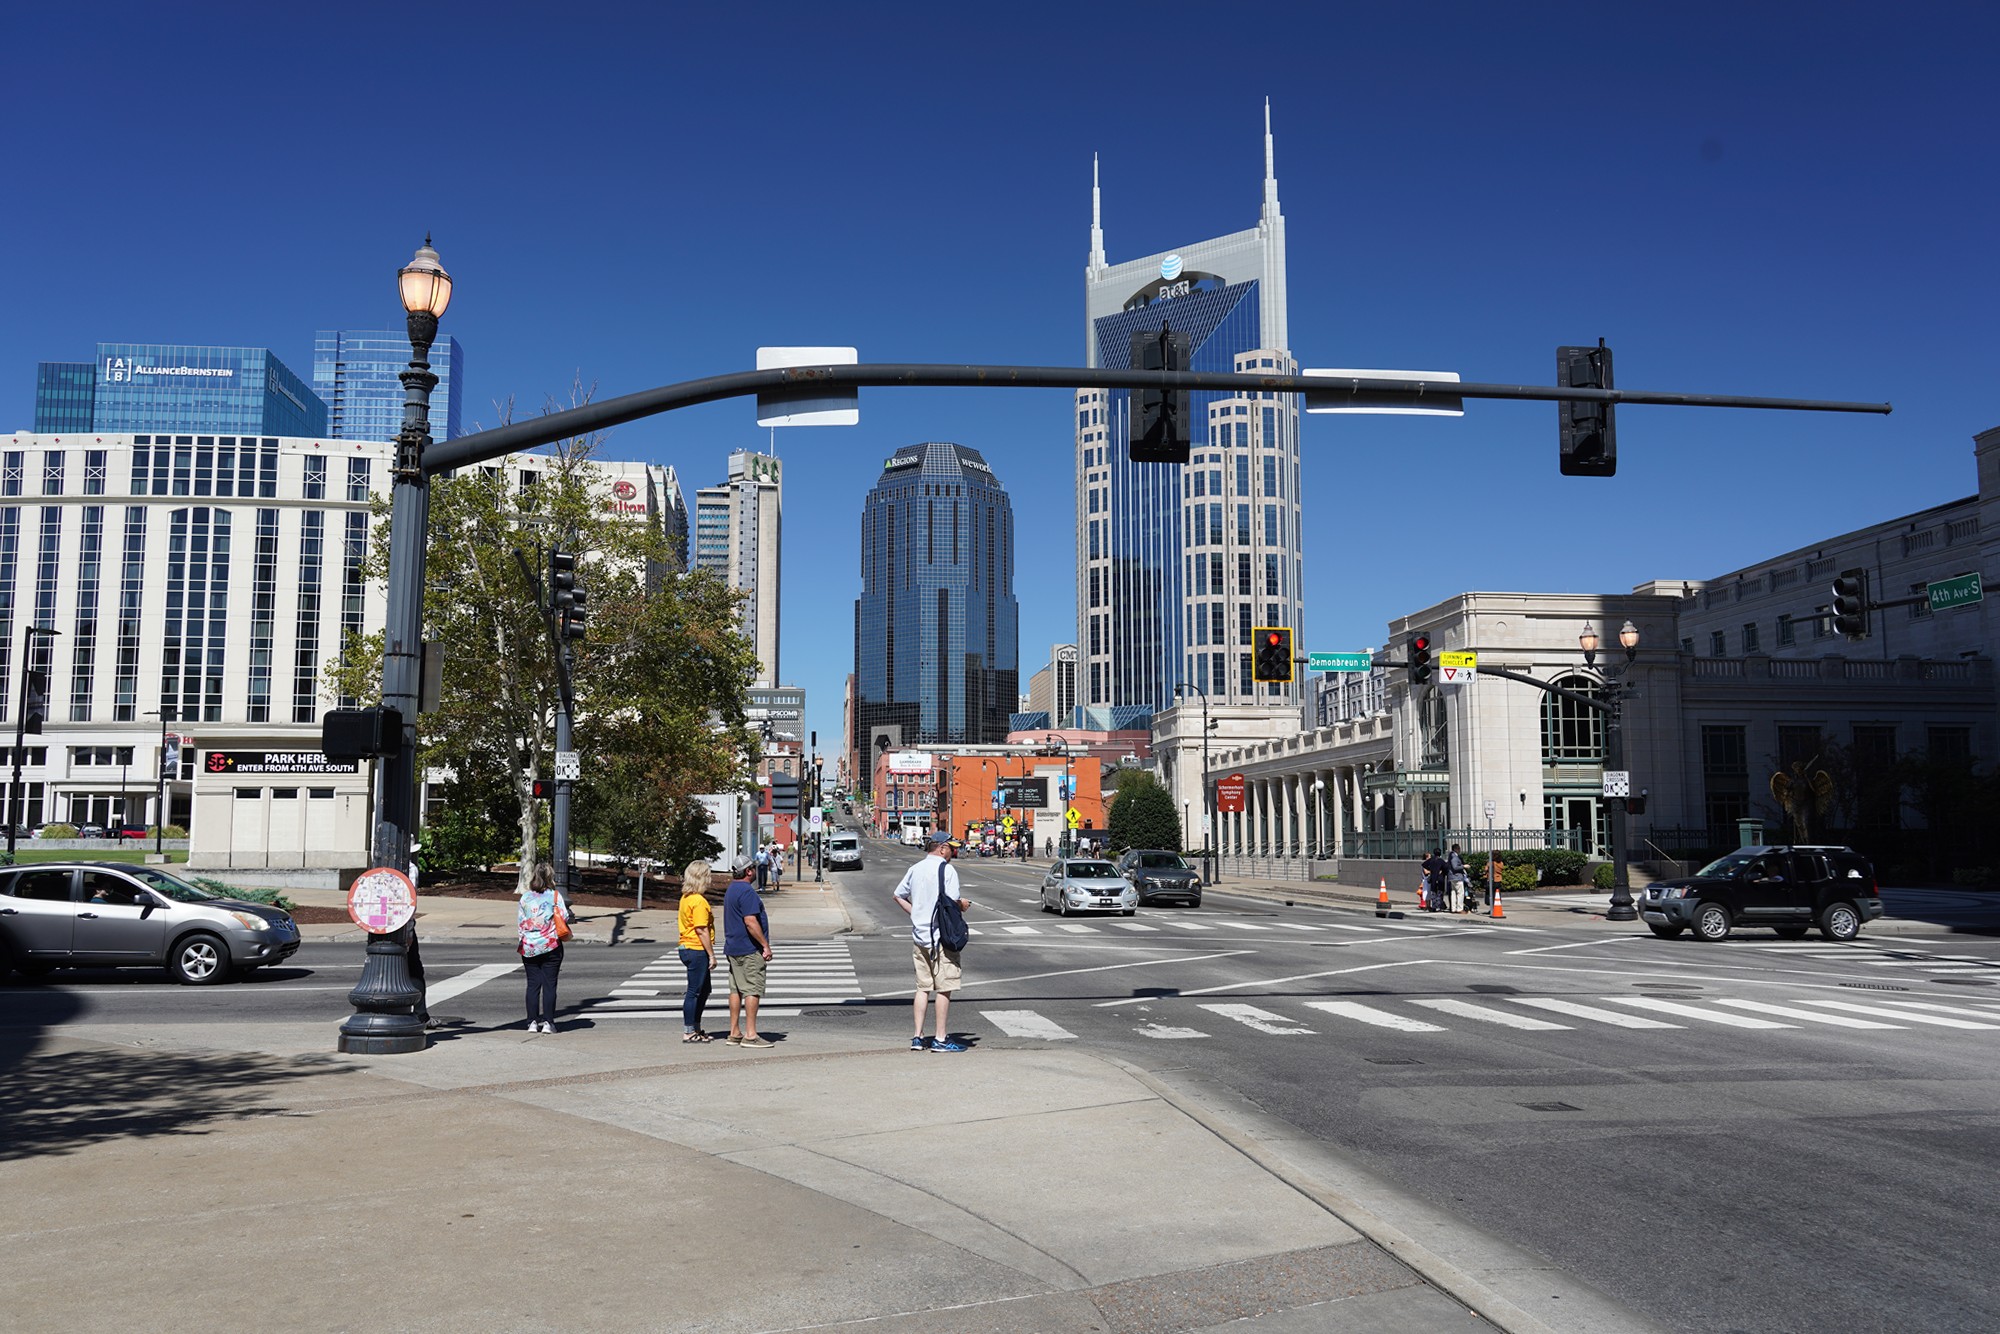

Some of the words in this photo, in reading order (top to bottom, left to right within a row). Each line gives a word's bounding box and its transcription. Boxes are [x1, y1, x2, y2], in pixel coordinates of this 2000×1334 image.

[1160, 281, 1188, 299] at&t
[1932, 589, 1951, 602] 4th
[1954, 588, 1969, 599] Ave
[1971, 581, 1980, 594] S
[1310, 657, 1358, 666] Demonbreun
[264, 754, 296, 764] PARK
[298, 754, 328, 764] HERE
[557, 766, 566, 775] OK
[1605, 784, 1614, 793] OK
